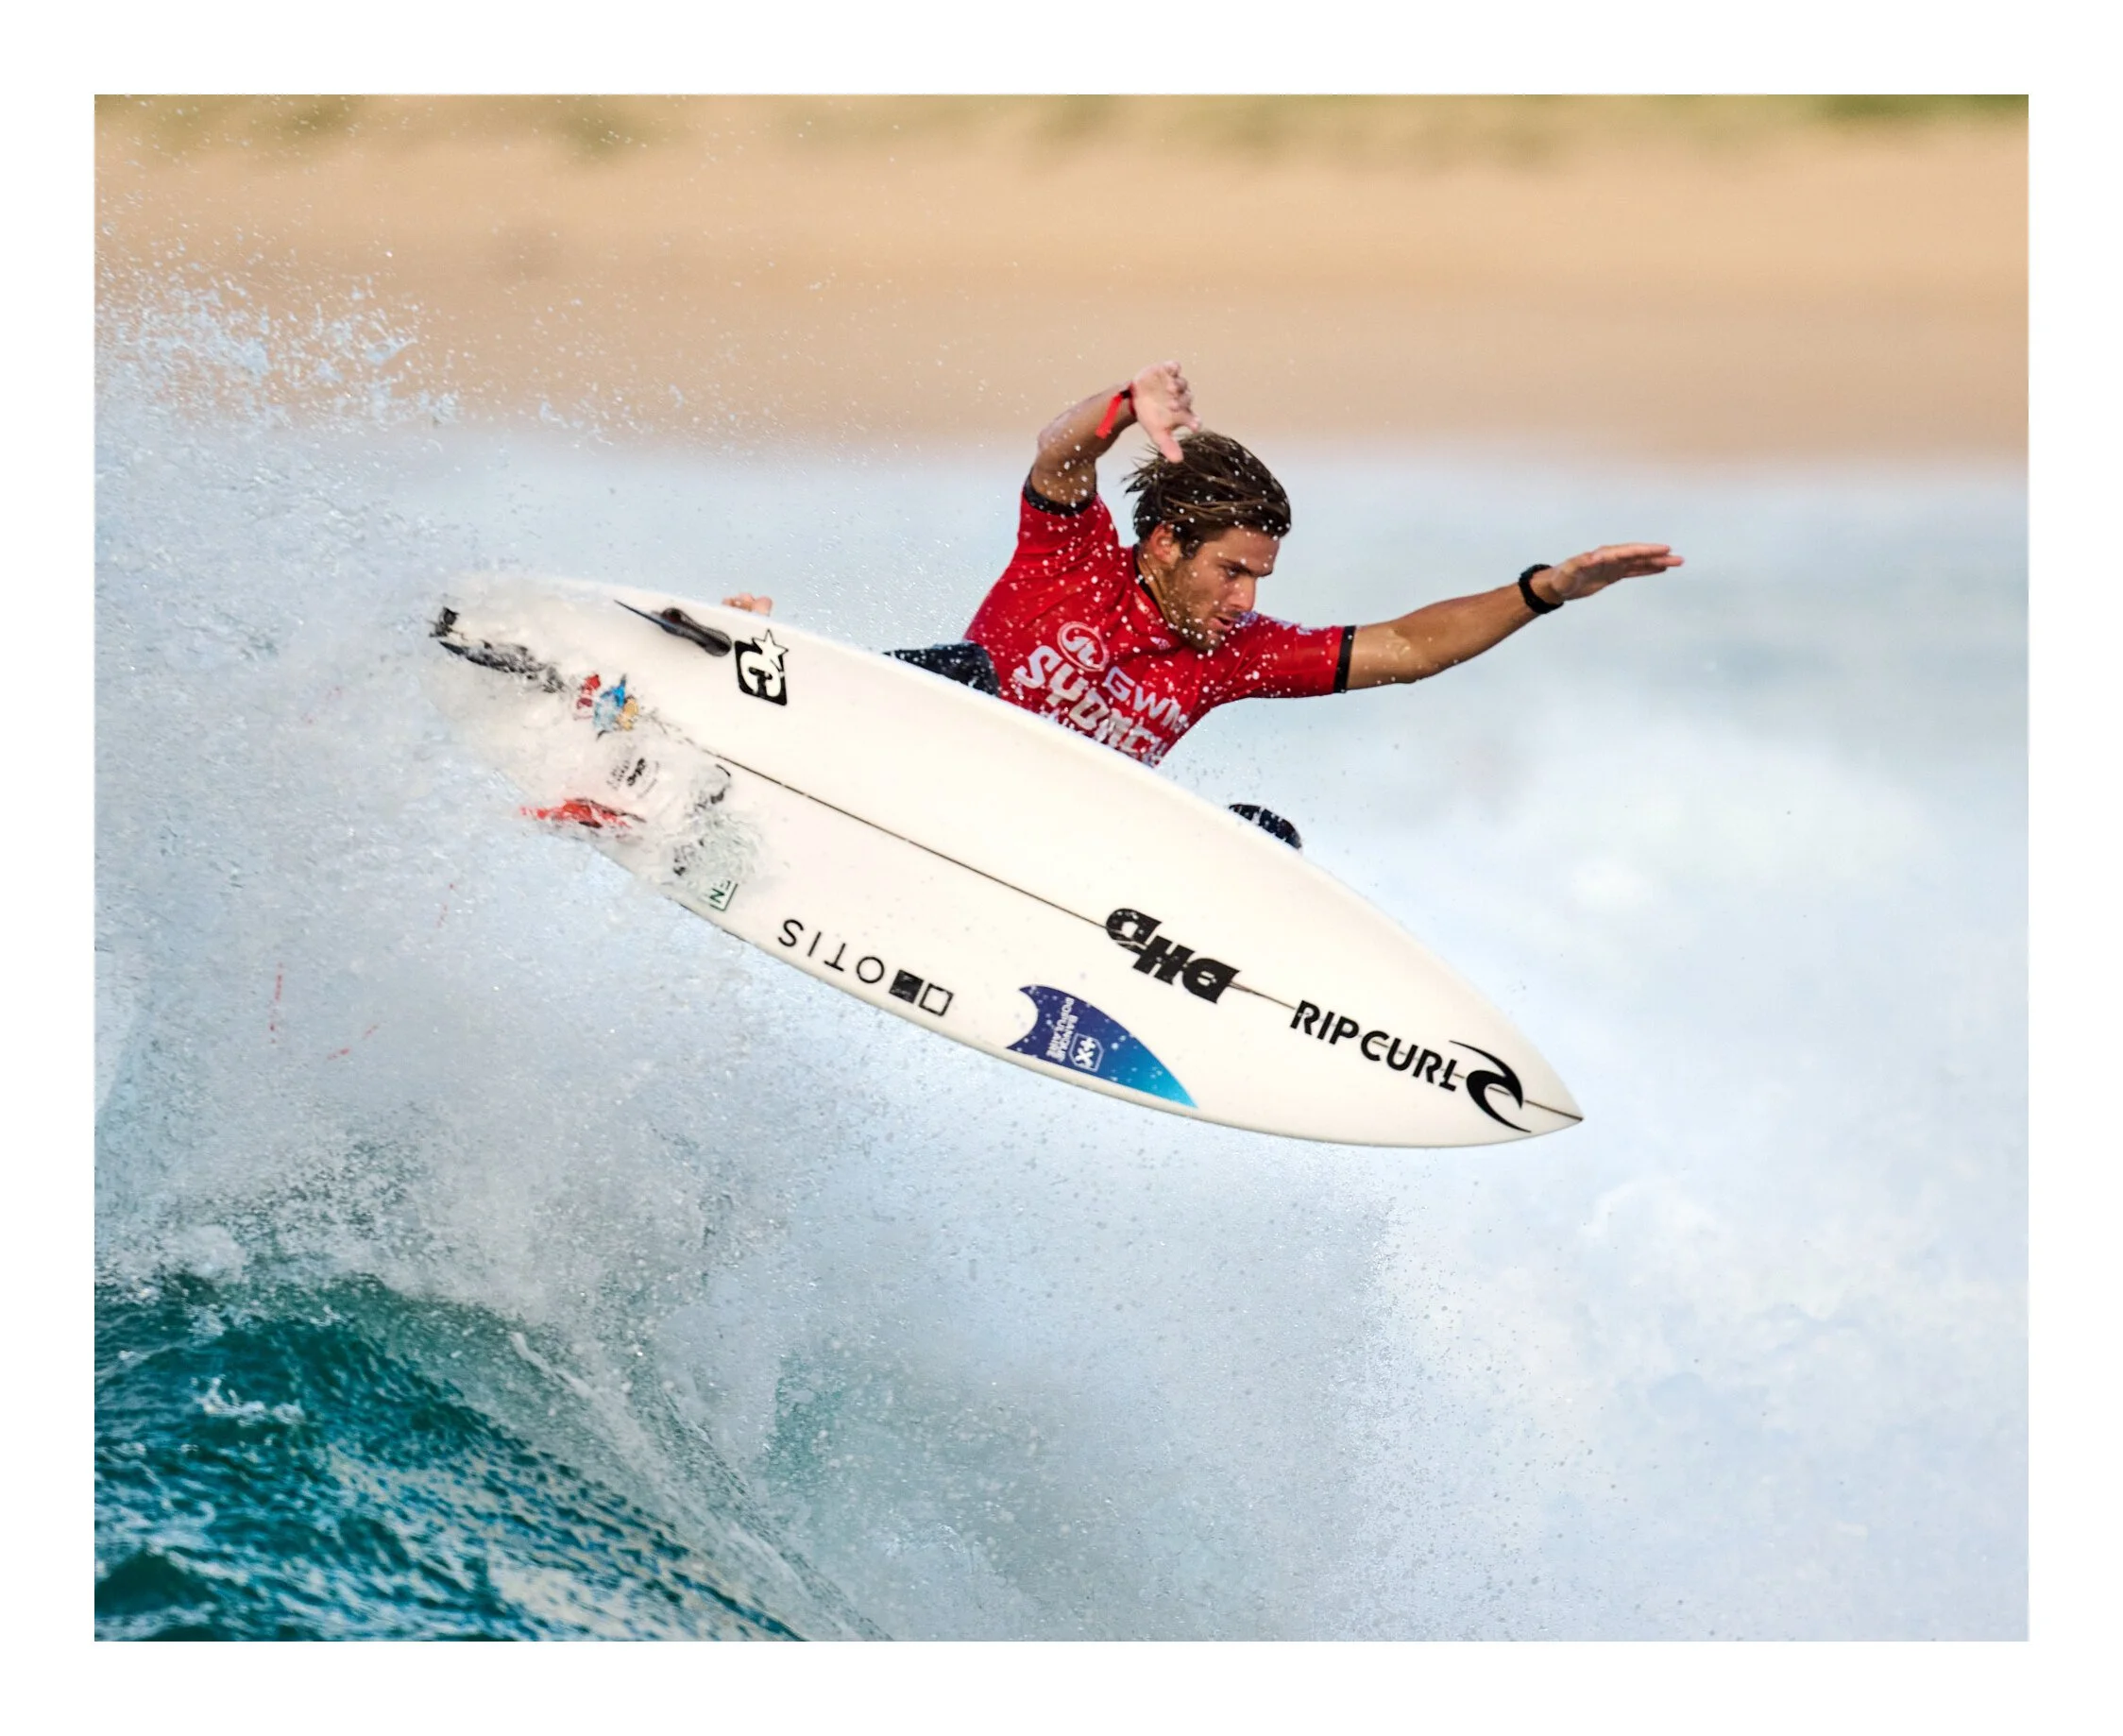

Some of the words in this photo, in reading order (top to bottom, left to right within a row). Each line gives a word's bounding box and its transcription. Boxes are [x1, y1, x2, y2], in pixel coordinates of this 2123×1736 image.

[1105, 666, 1189, 734] GWM
[777, 919, 885, 984] OTIS
[1105, 908, 1242, 1004] DHD
